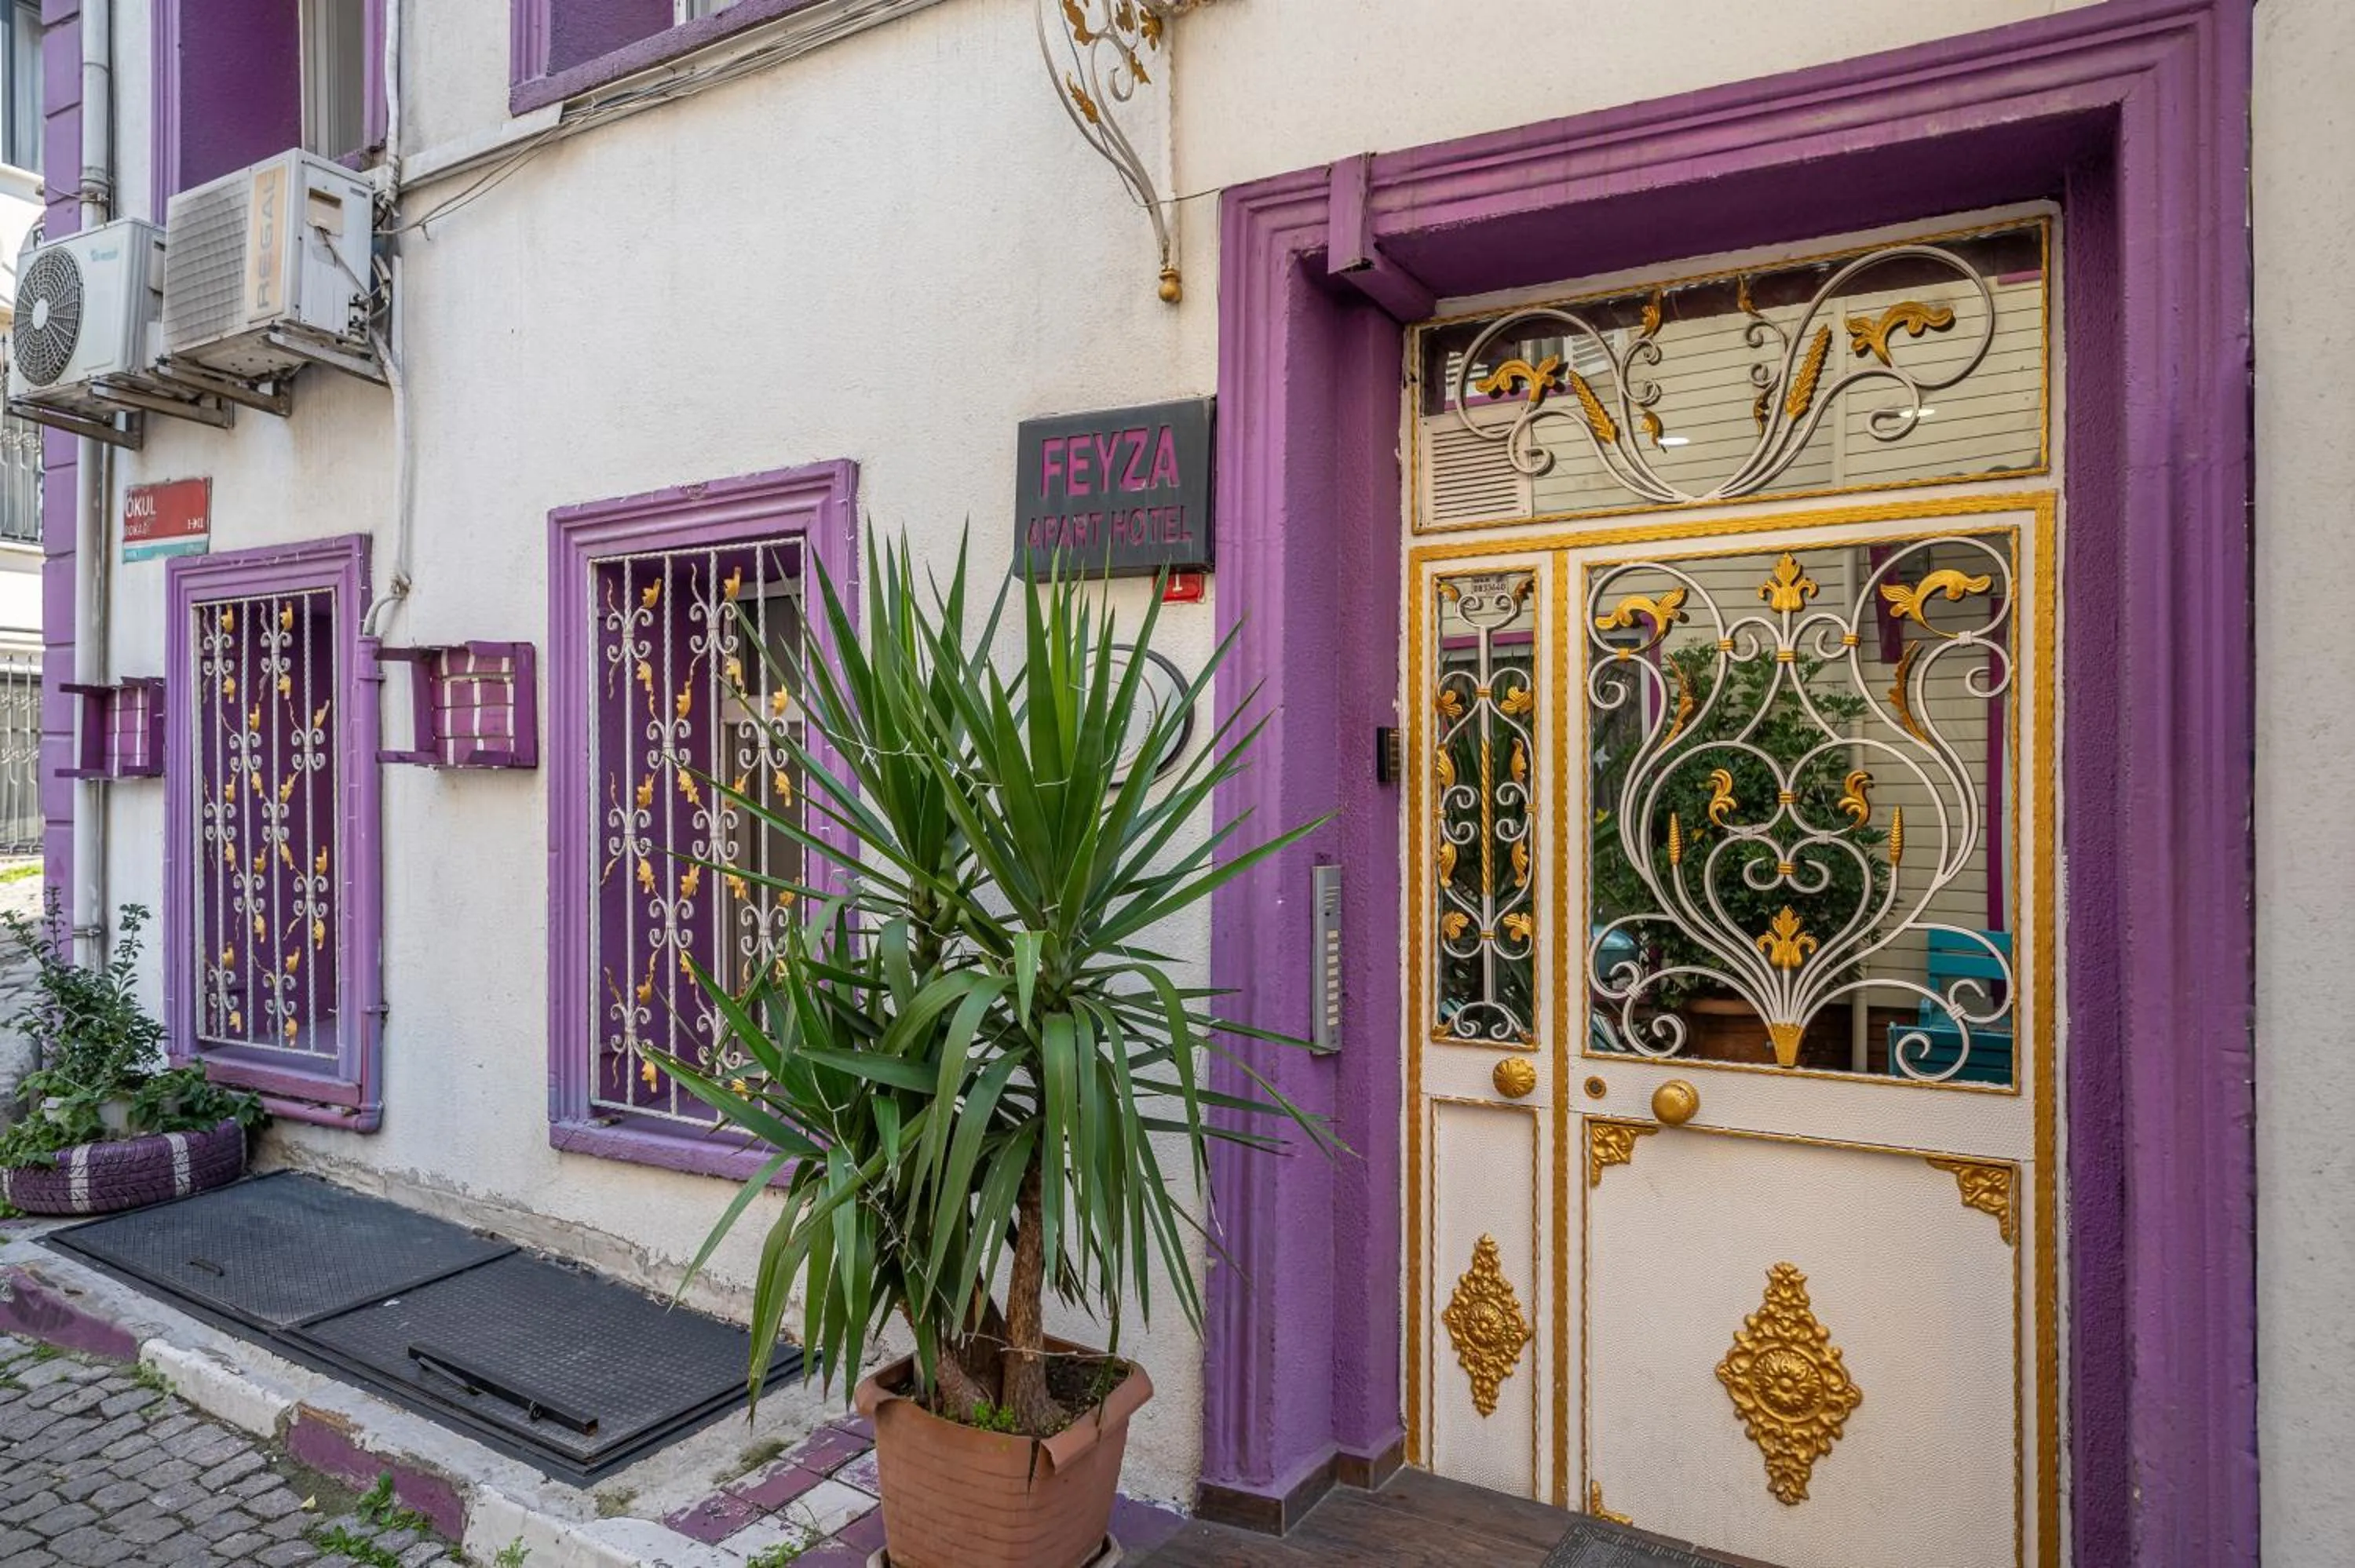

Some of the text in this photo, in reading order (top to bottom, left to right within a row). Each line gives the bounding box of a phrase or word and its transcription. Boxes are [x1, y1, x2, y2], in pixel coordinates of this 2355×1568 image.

[257, 170, 276, 309] REGAL
[1041, 425, 1180, 499] FEYZA
[1029, 505, 1193, 550] APART HOTEL
